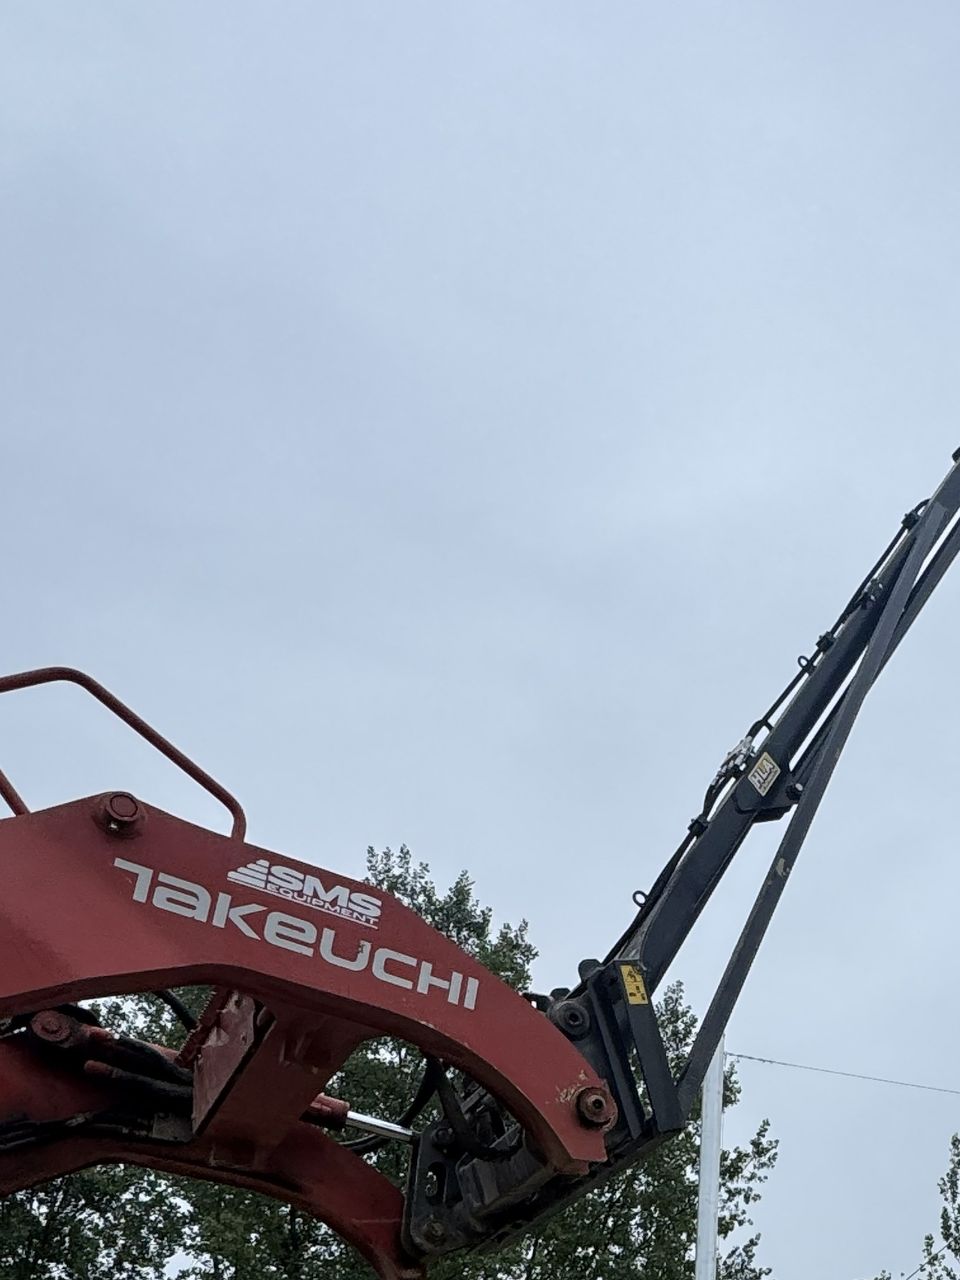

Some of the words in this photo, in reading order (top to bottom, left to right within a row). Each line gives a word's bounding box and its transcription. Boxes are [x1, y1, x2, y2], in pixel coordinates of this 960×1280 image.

[751, 758, 775, 790] HLA
[267, 865, 382, 917] SMS
[267, 882, 380, 925] EQUIPMENT
